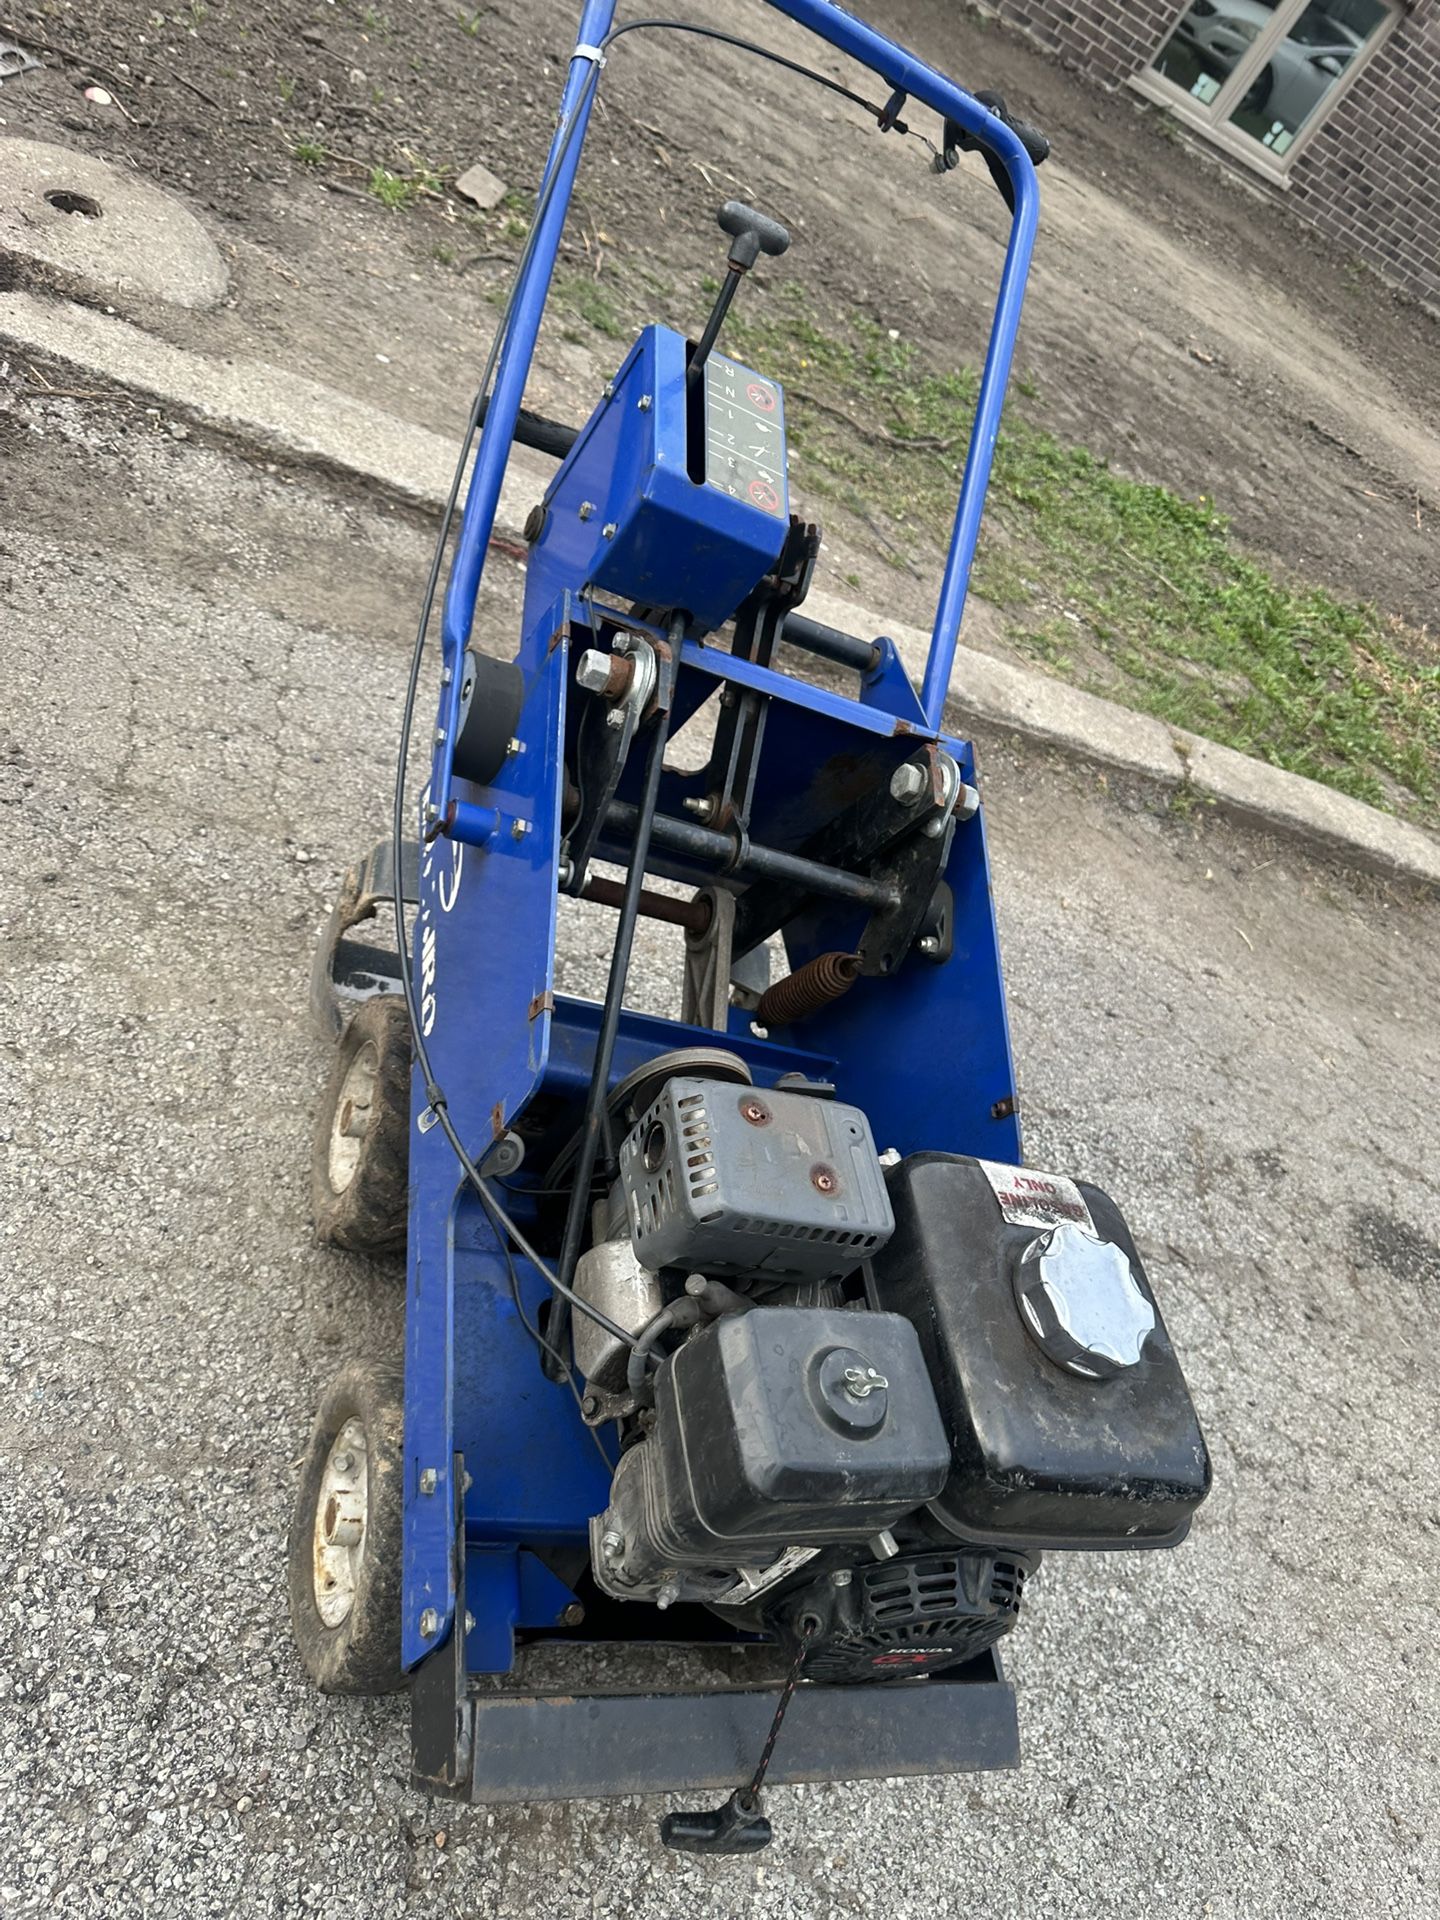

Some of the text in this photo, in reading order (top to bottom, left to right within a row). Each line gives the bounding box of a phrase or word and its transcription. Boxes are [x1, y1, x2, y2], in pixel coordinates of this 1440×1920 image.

[725, 365, 735, 377] R
[725, 386, 736, 398] N
[728, 410, 735, 419] 1
[727, 433, 736, 445] 2
[727, 457, 736, 468] 3
[727, 485, 736, 495] 4
[1013, 1176, 1056, 1194] ONLY
[998, 1191, 1085, 1218] GASOLINE
